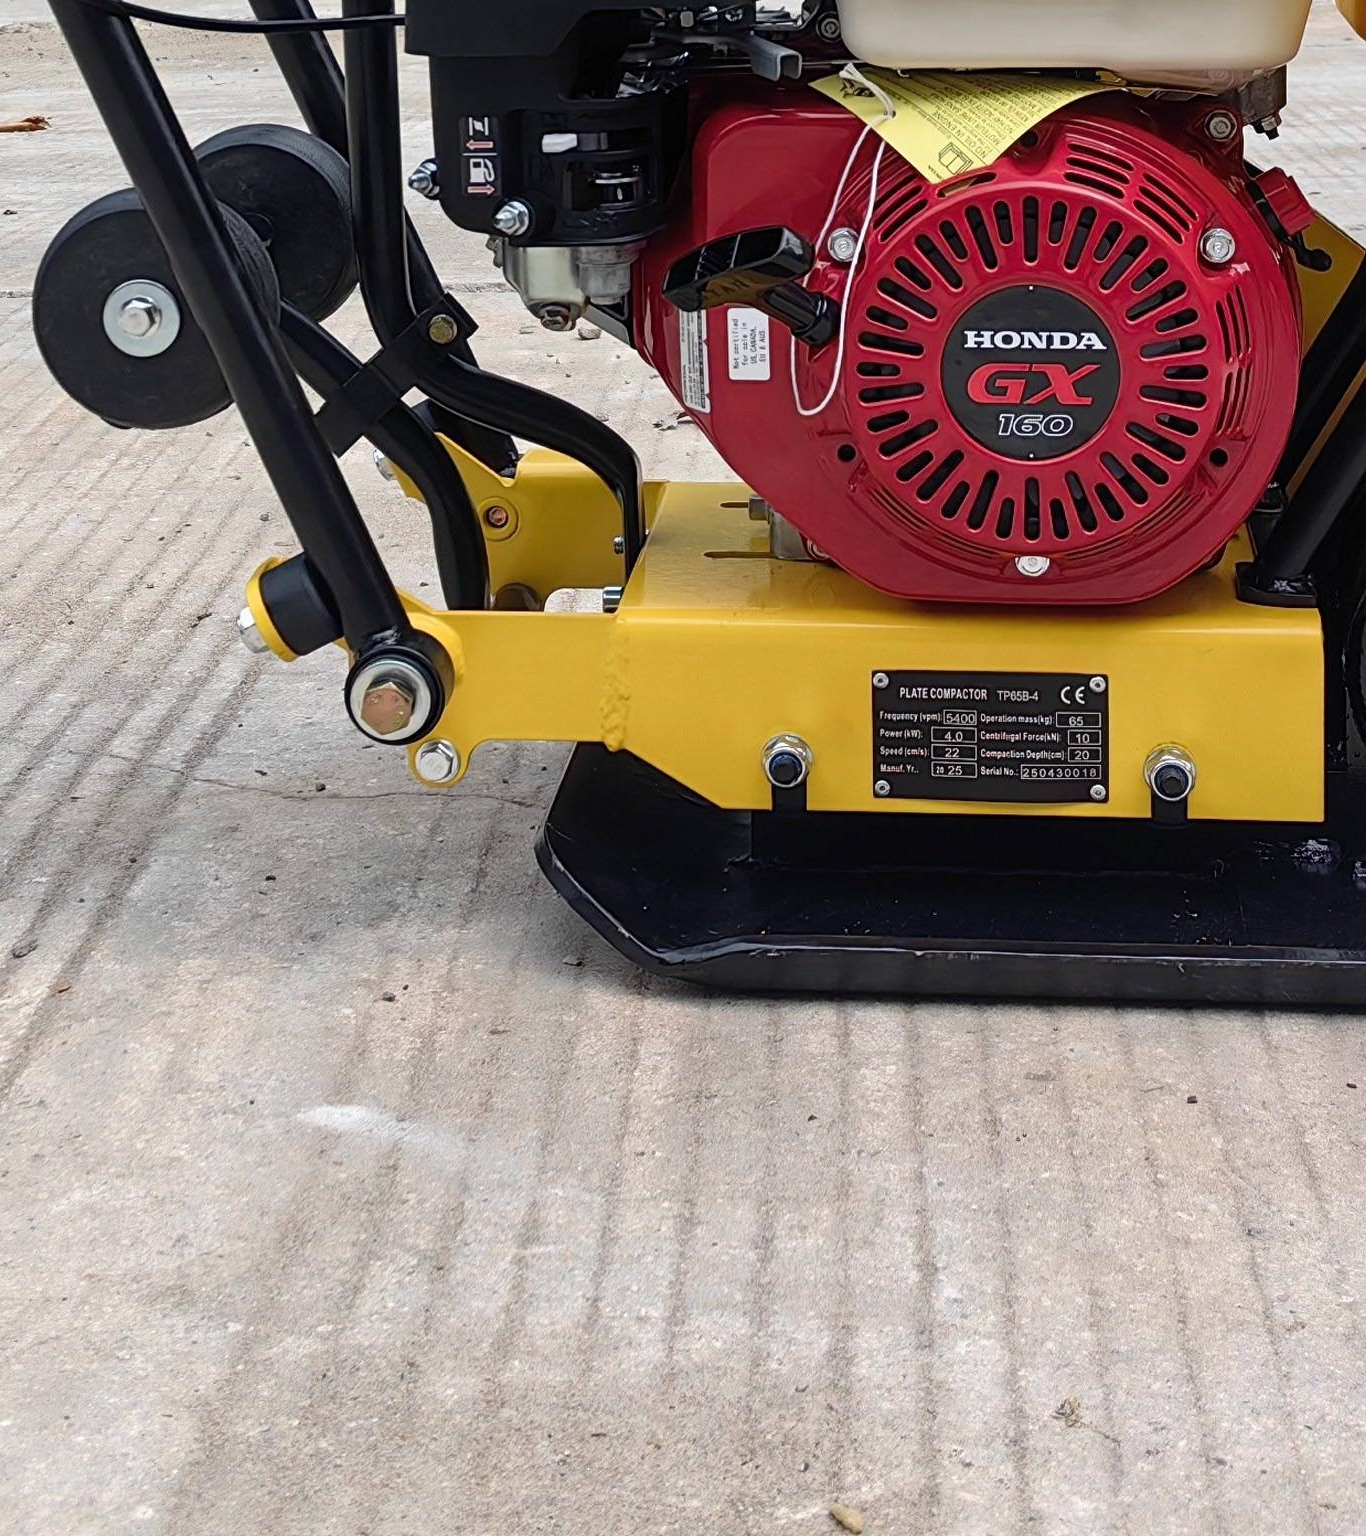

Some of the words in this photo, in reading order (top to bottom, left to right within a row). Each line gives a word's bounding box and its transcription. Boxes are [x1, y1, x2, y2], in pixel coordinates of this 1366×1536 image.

[964, 330, 1107, 350] HONDA
[967, 362, 1101, 405] GX
[998, 413, 1074, 437] 160
[899, 687, 928, 700] PLATE
[930, 687, 988, 701] COMPACTOR
[997, 690, 1039, 702] TP65B-4
[1060, 685, 1086, 705] CE
[879, 710, 918, 722] Frequency
[946, 713, 975, 724] 5400
[980, 713, 1016, 724] Operation
[1018, 715, 1054, 726] mass(kg):
[1069, 716, 1084, 726] 65
[879, 728, 903, 738] Power
[904, 728, 923, 739] (kW):
[944, 731, 963, 742] 4.0
[980, 731, 1022, 743] Centrifugal
[1075, 734, 1090, 744] 10
[879, 746, 904, 756] Speed
[944, 747, 960, 758] 22
[980, 748, 1025, 759] Compaction
[1074, 750, 1090, 760] 20
[980, 766, 1003, 776] Serial
[1022, 768, 1097, 778] 250430018
